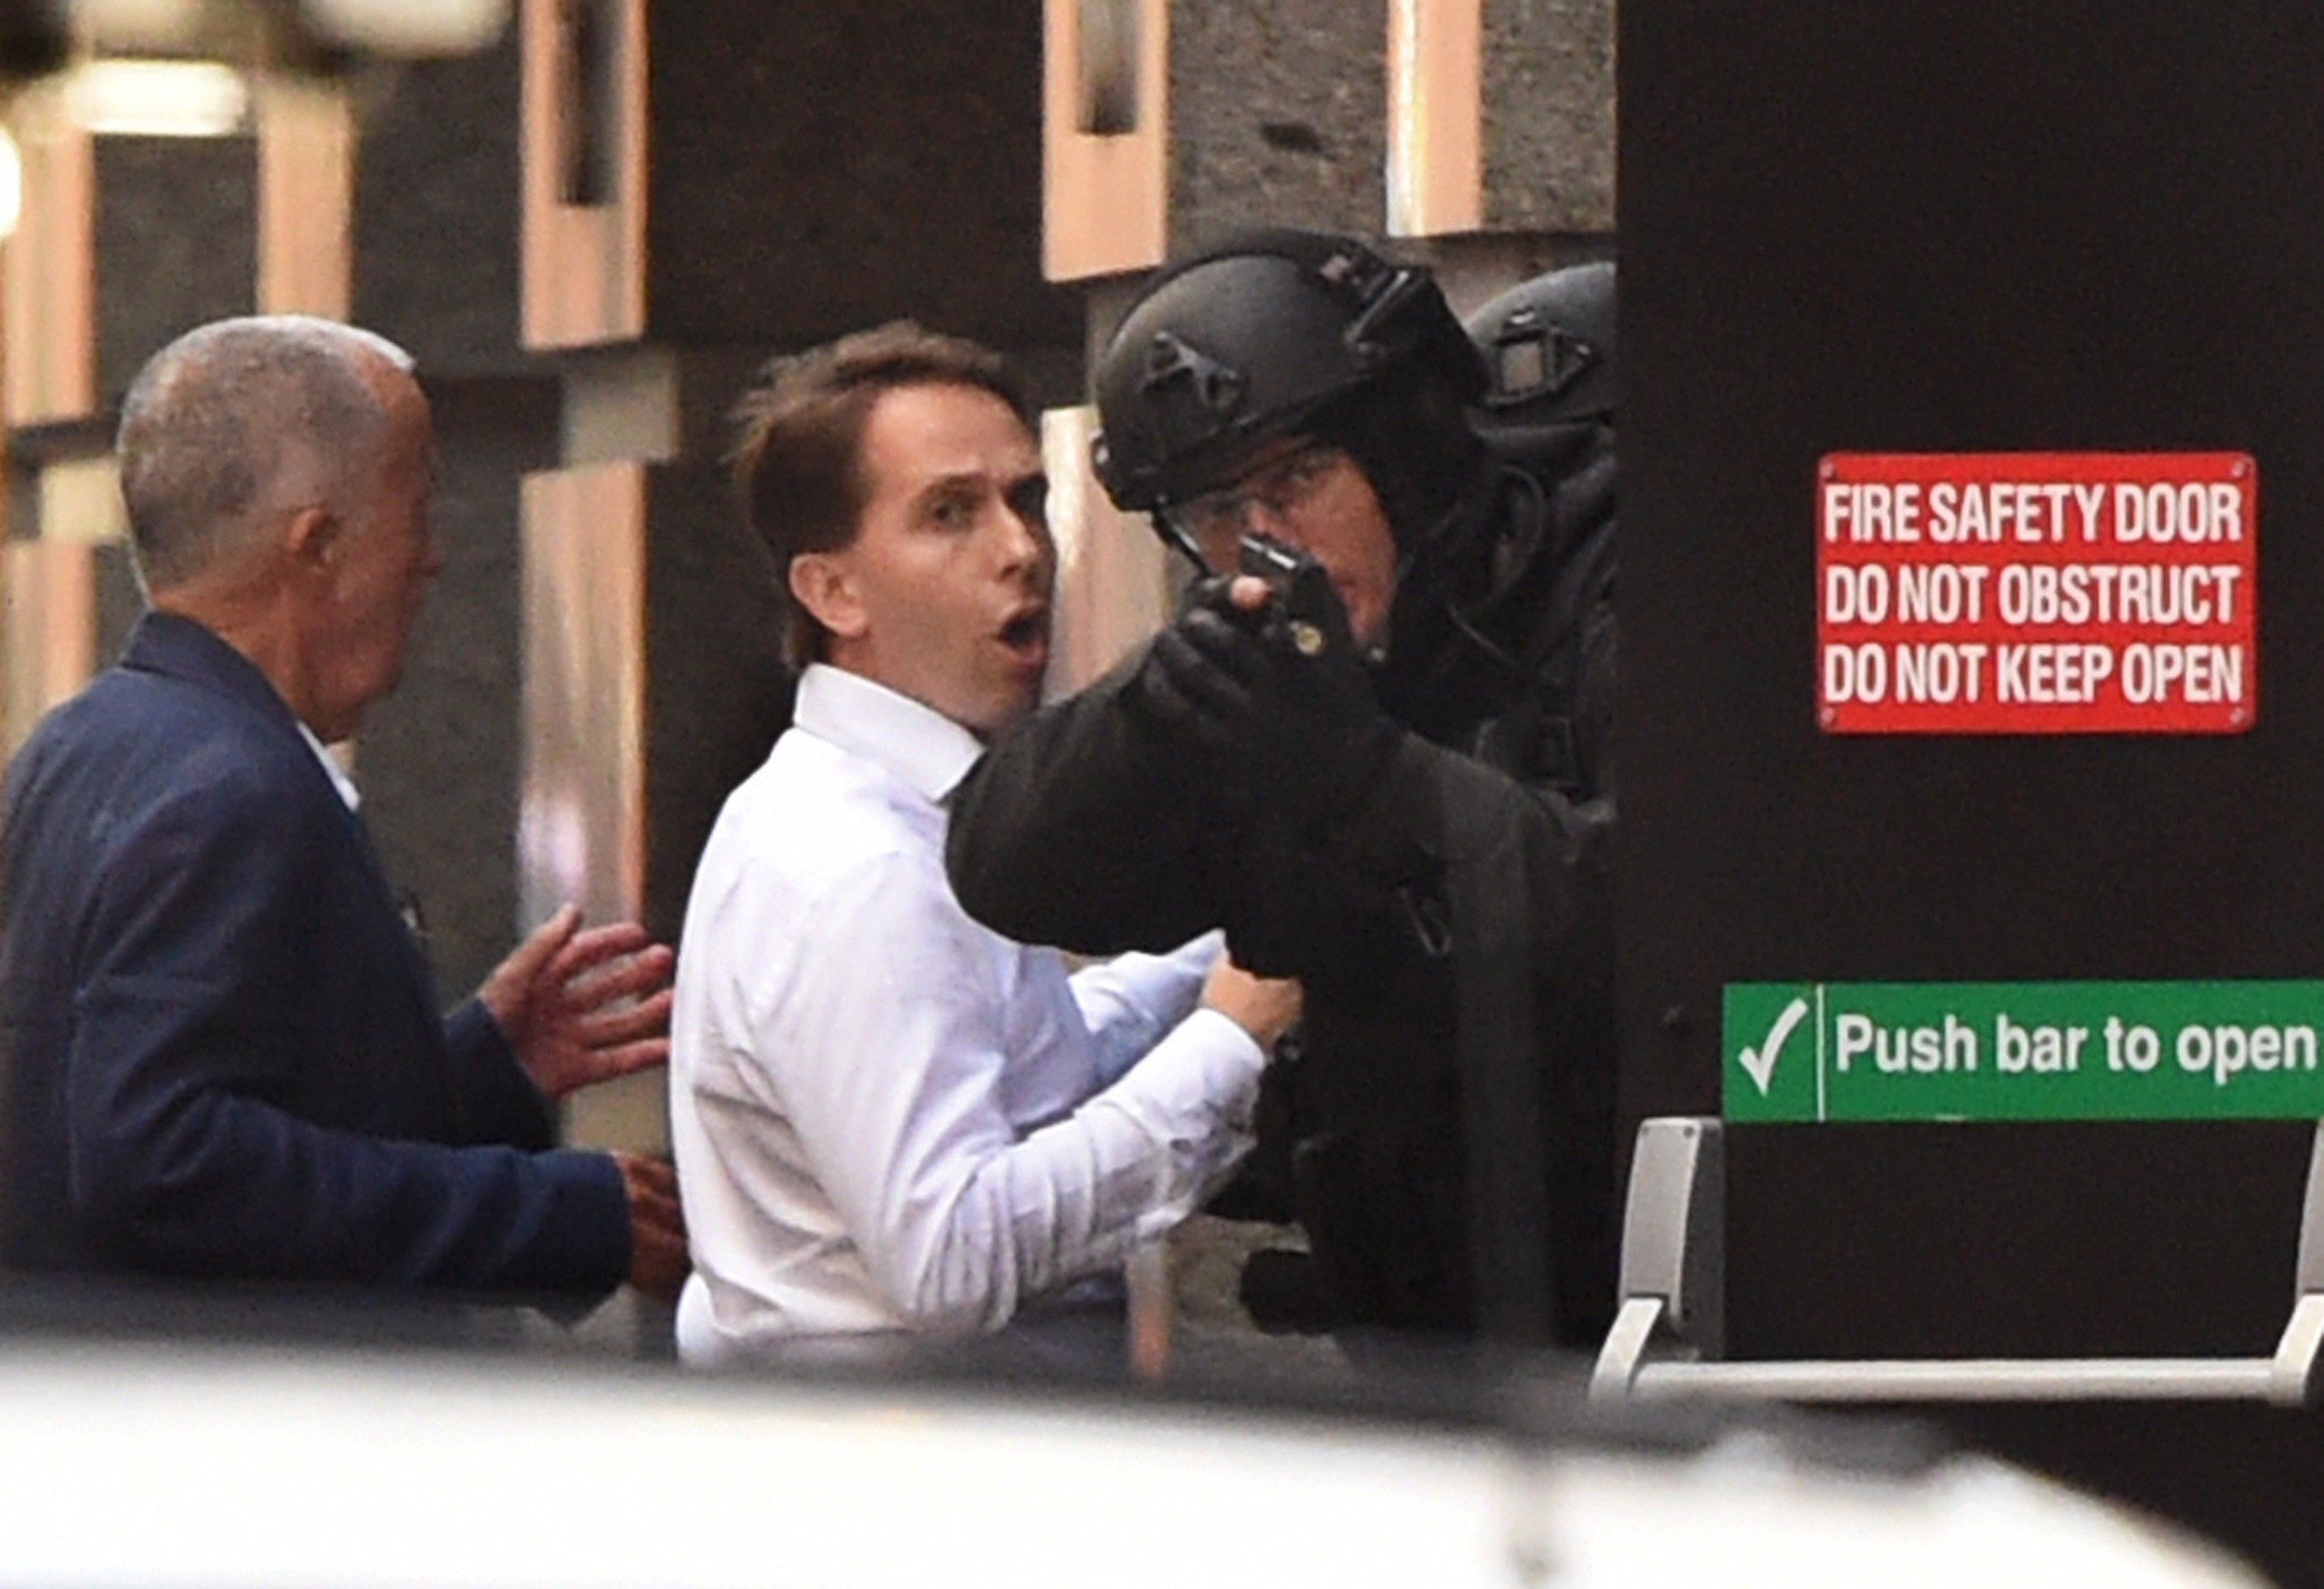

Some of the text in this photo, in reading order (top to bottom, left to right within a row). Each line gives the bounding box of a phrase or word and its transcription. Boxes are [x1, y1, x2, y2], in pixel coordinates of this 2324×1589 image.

[1824, 482, 2243, 544] FIRE SAFETY DOOR
[1825, 563, 2242, 626] DO NOT OBSTRUCT
[1823, 642, 2244, 705] DO NOT KEEP OPEN
[1836, 1013, 2318, 1086] Push bar to open
